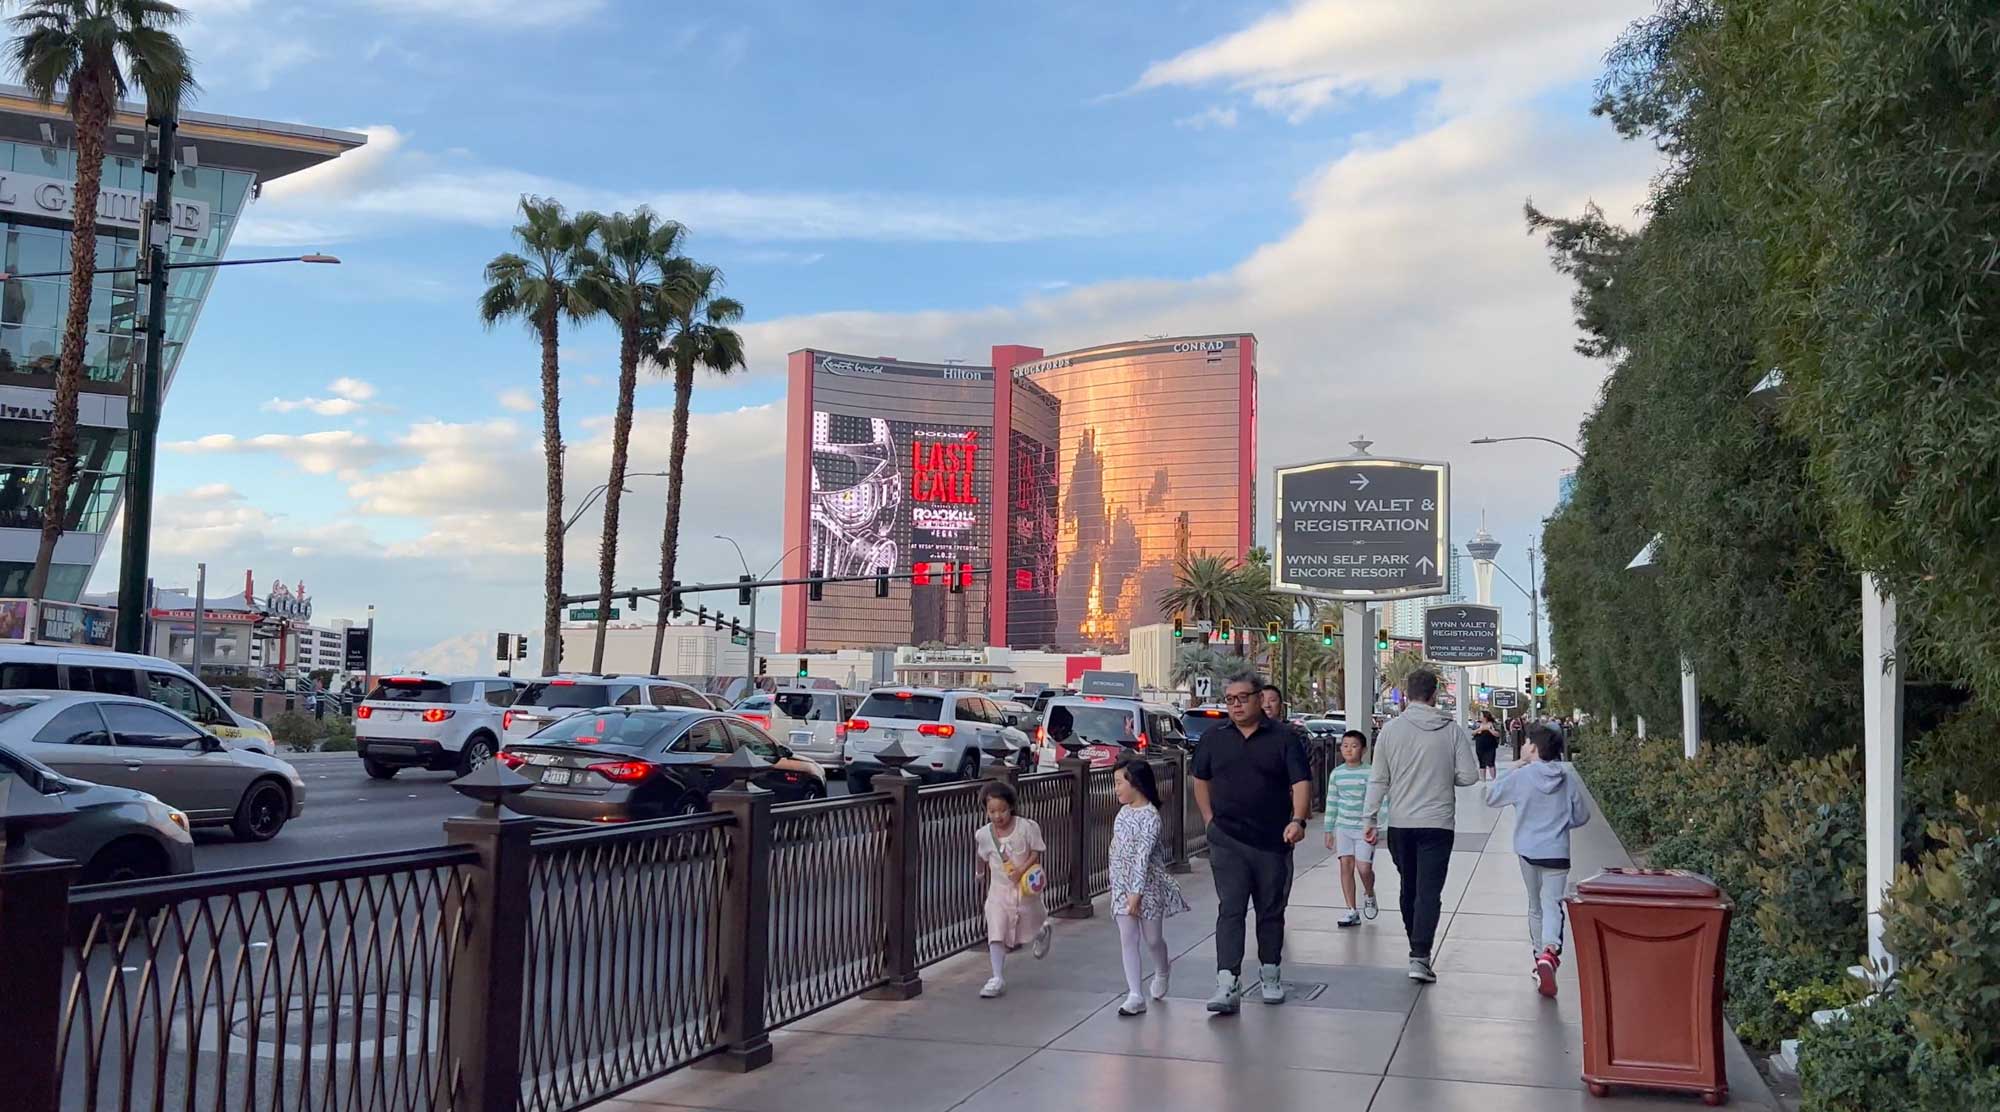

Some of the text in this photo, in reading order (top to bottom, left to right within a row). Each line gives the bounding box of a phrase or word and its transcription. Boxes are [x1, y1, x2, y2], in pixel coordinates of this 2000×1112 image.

[1173, 341, 1224, 352] CONRAD
[943, 368, 982, 381] Hilton
[0, 404, 53, 420] ITALY
[914, 430, 968, 439] DODGE
[912, 441, 978, 472] LAST
[912, 471, 978, 503] CALL
[1290, 498, 1434, 512] WYNN VALET &
[913, 507, 976, 521] ROADKILL
[1294, 519, 1429, 532] REGISTRATION
[1286, 554, 1410, 565] WYNN SELF PARK
[1289, 568, 1407, 577] ENCORE RESORT
